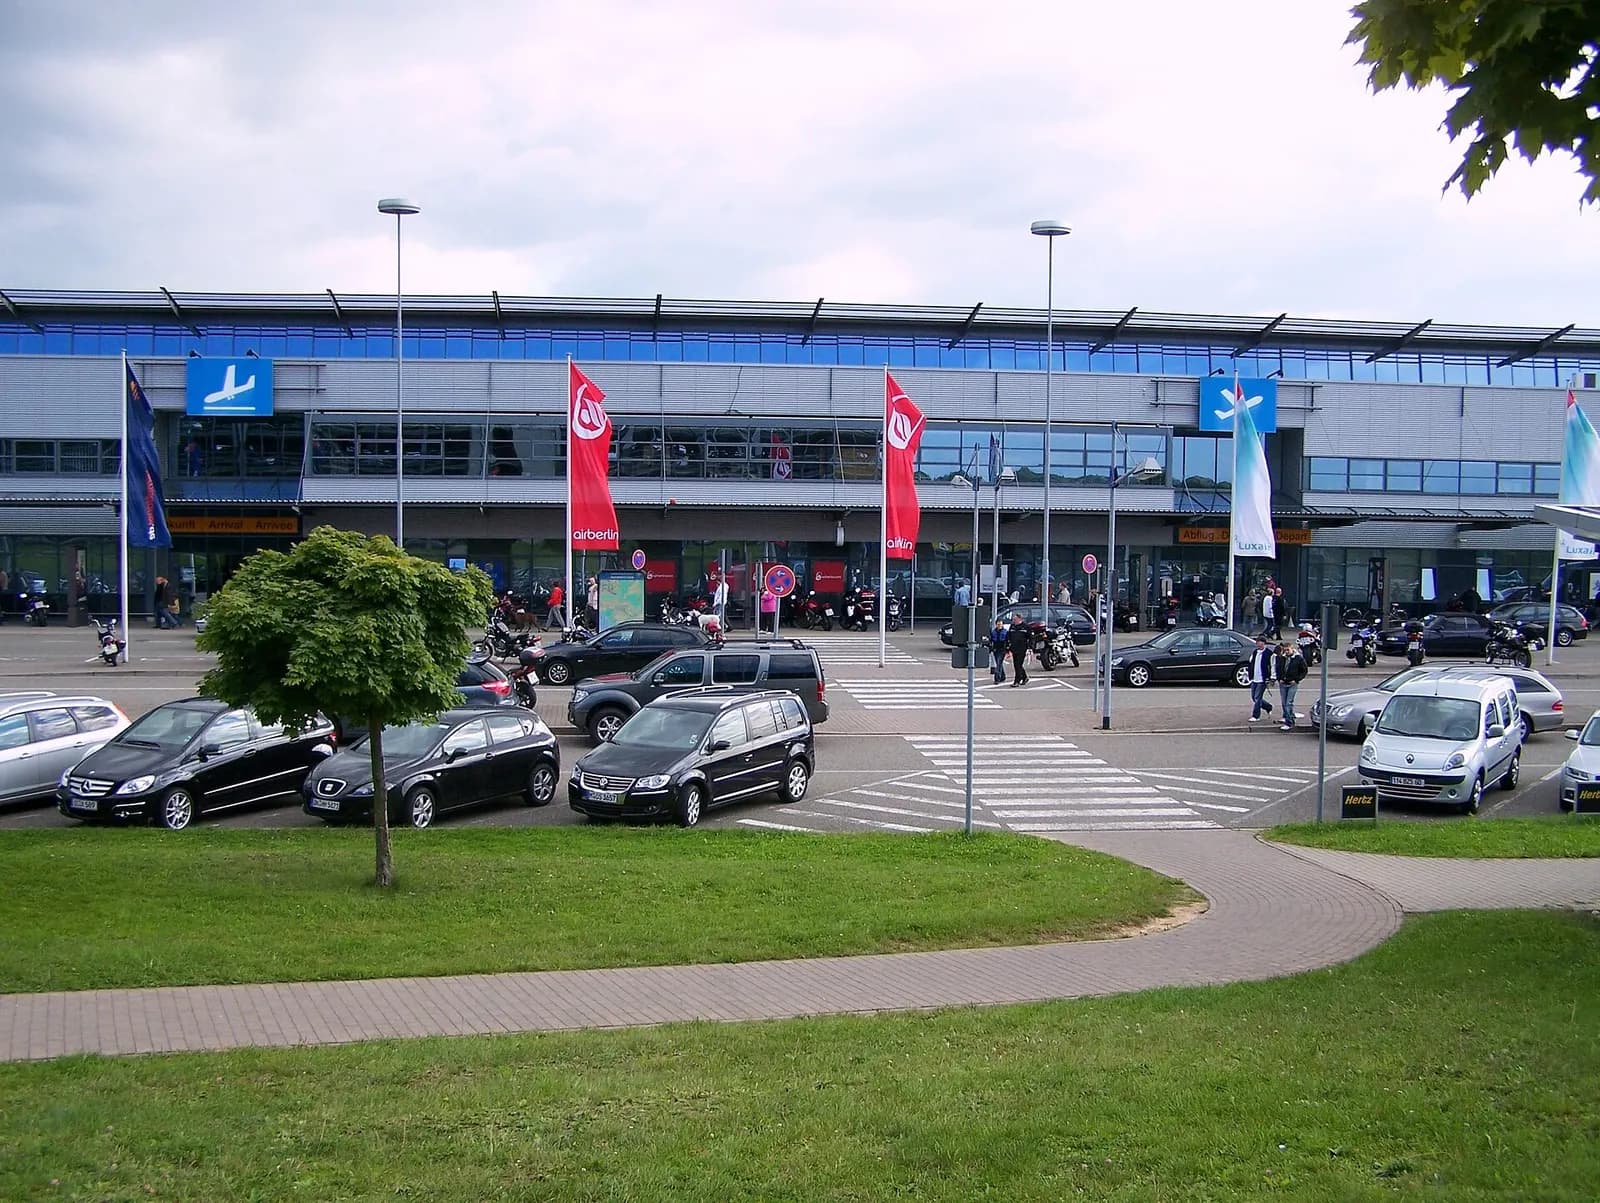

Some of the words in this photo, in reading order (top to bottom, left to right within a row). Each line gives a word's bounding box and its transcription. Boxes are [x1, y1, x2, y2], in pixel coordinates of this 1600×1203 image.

[208, 519, 243, 529] Arrival
[573, 529, 618, 540] airberlin
[1183, 530, 1214, 542] Abflug
[1345, 795, 1373, 805] Hertz
[1579, 790, 1600, 800] Hert
